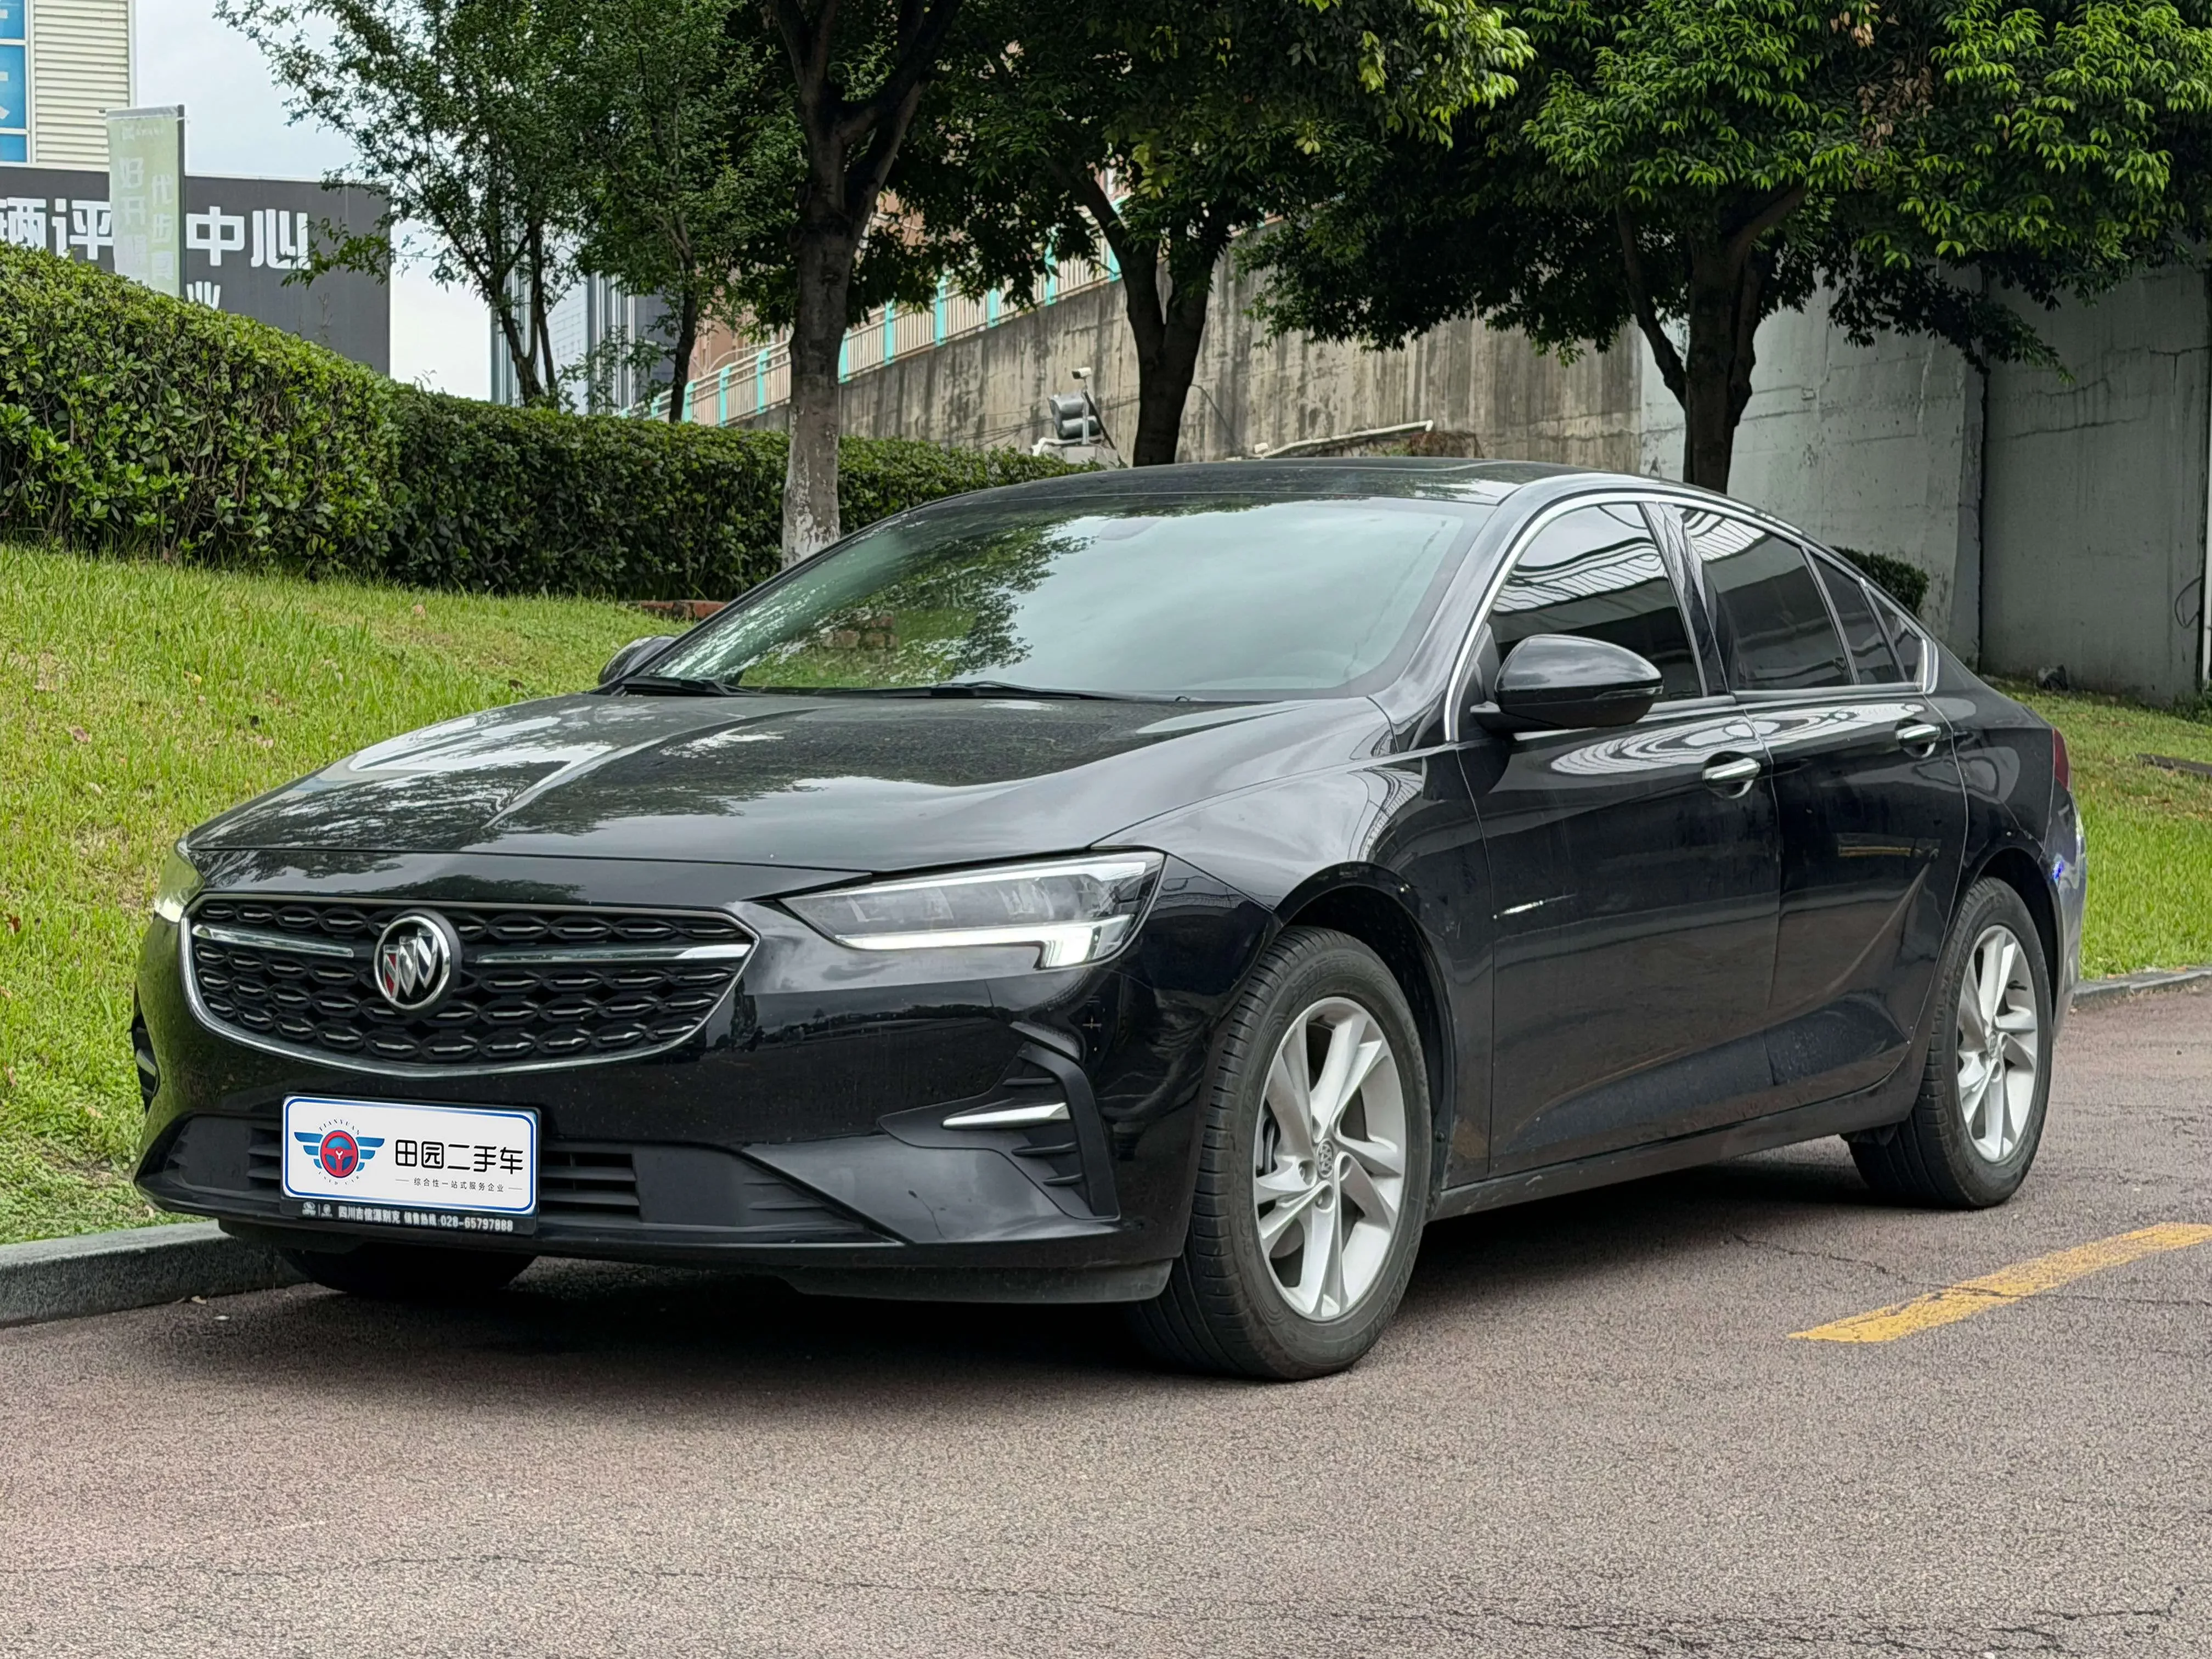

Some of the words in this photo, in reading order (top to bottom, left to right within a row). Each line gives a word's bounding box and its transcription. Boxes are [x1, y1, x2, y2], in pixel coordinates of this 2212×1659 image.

[395, 1139, 524, 1175] 田园二手车
[414, 1177, 504, 1193] 综合性一站式服务企业
